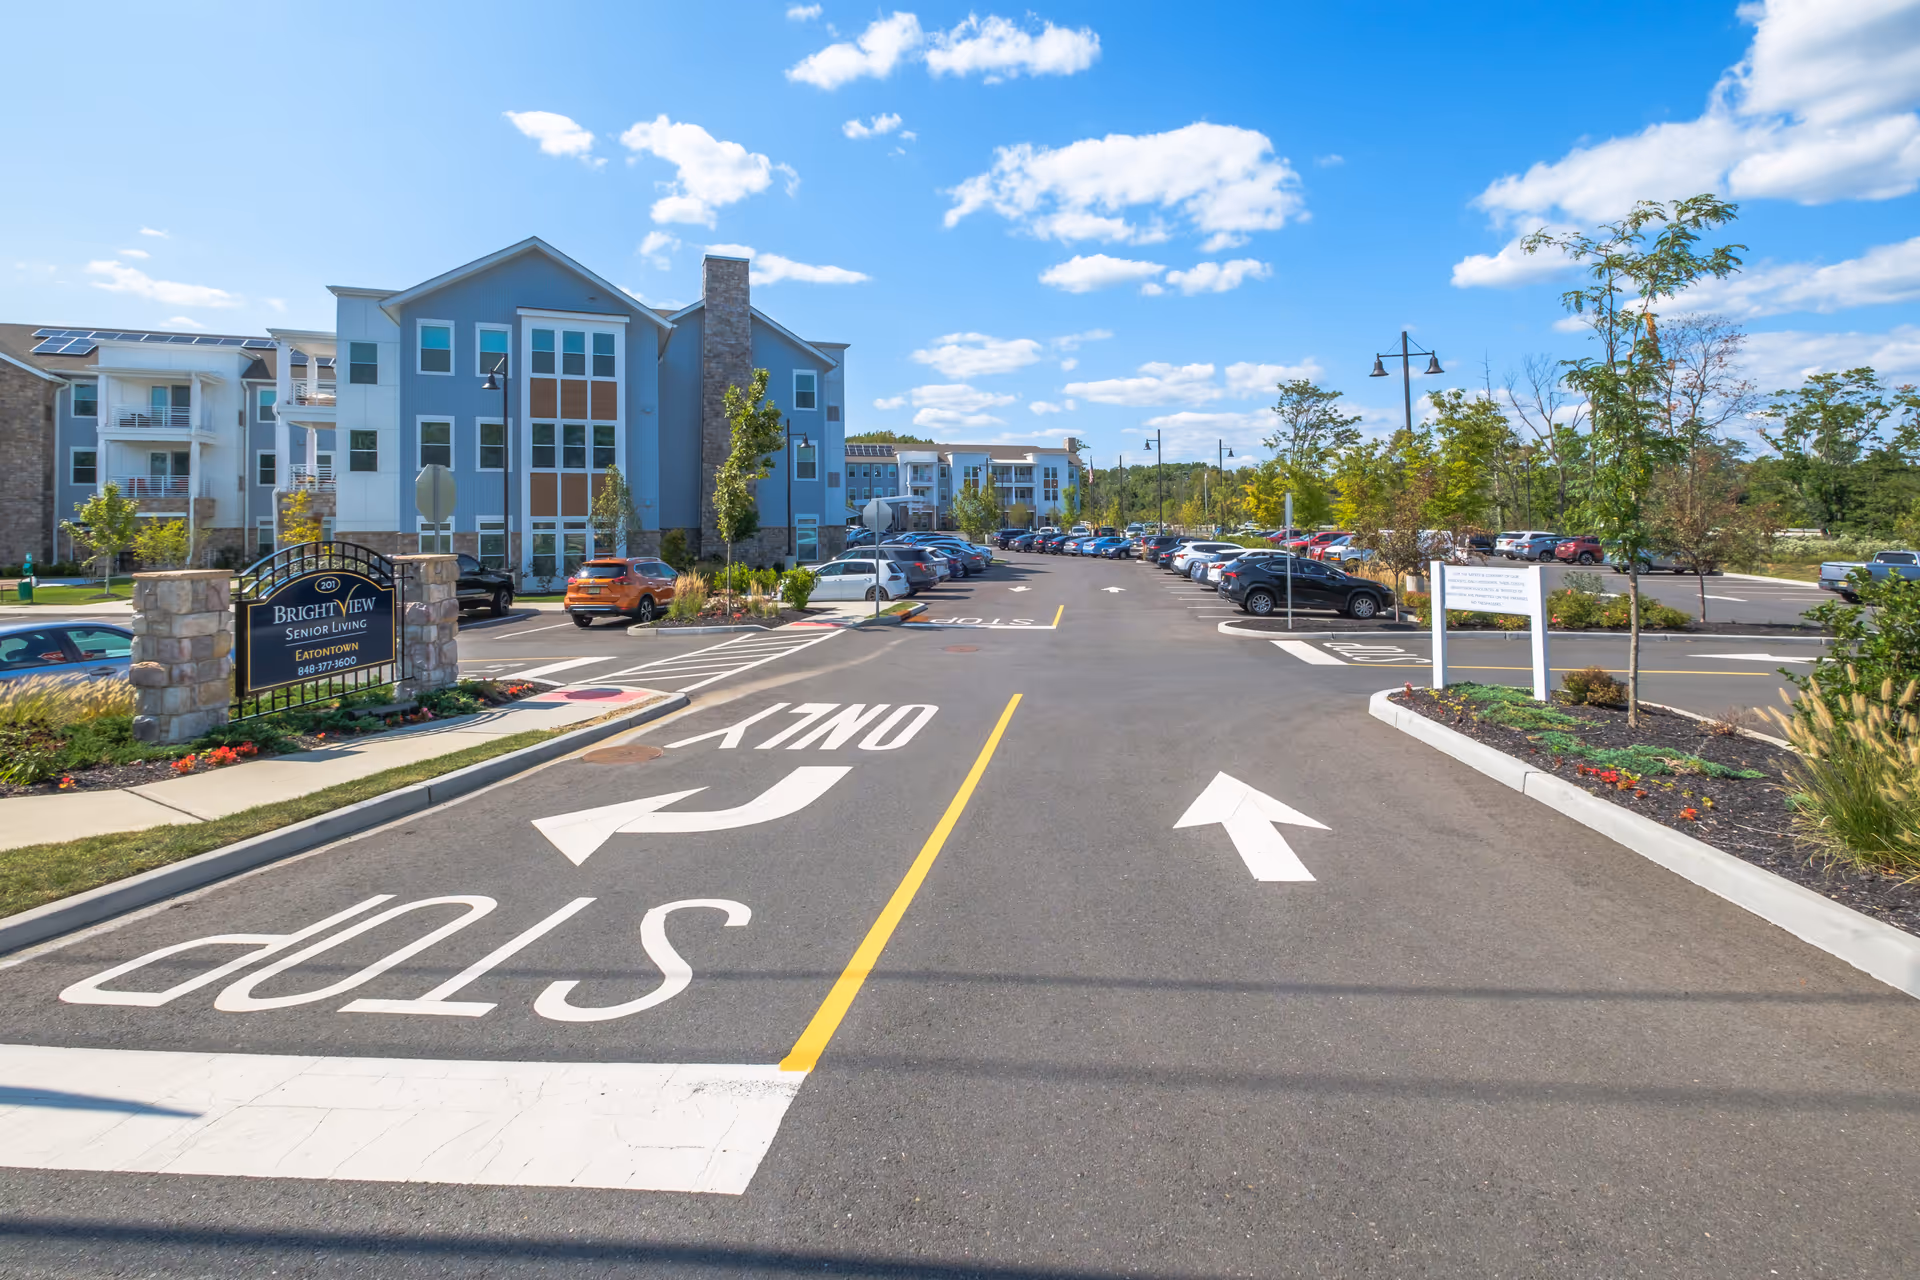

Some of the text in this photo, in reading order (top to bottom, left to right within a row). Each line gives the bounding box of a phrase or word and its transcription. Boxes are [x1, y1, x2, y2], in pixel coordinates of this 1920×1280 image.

[320, 581, 336, 590] 201
[273, 584, 376, 624] BRIGHTVIEW
[285, 619, 367, 640] SENIOR LIVING
[929, 616, 1034, 625] STOP
[295, 642, 359, 661] EATONTOWN
[297, 656, 357, 676] 848-377-3600
[664, 702, 940, 751] ONLY
[59, 893, 753, 1023] STOP
